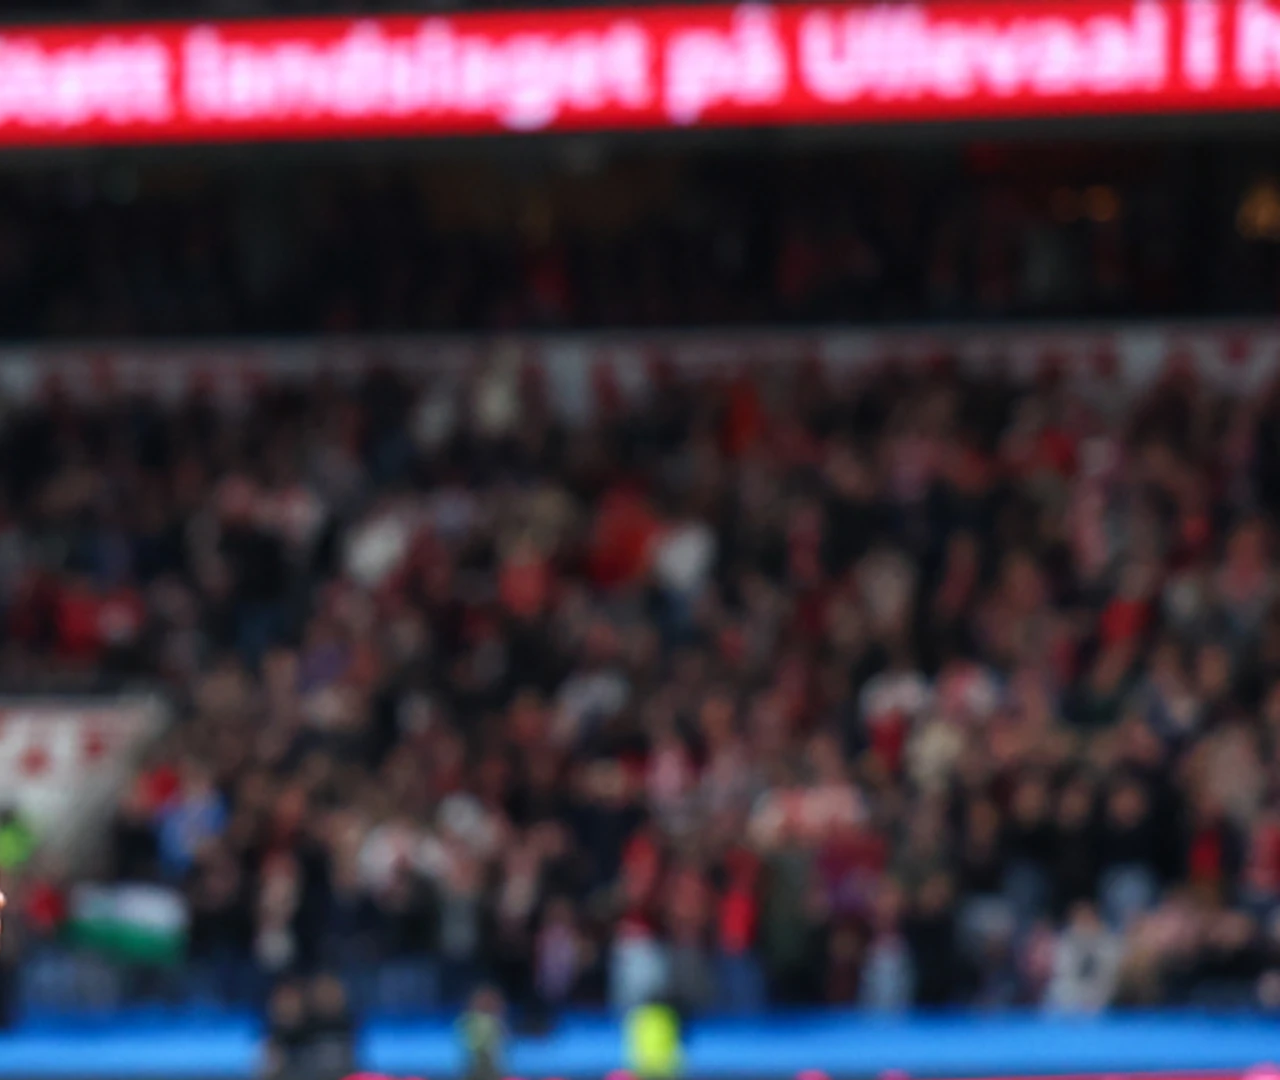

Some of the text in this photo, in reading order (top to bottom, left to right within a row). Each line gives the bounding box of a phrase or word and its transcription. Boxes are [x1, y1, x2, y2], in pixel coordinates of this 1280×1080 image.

[182, 17, 648, 132] landslaget
[664, 1, 786, 126] på
[798, 0, 1168, 102] Ullevaal
